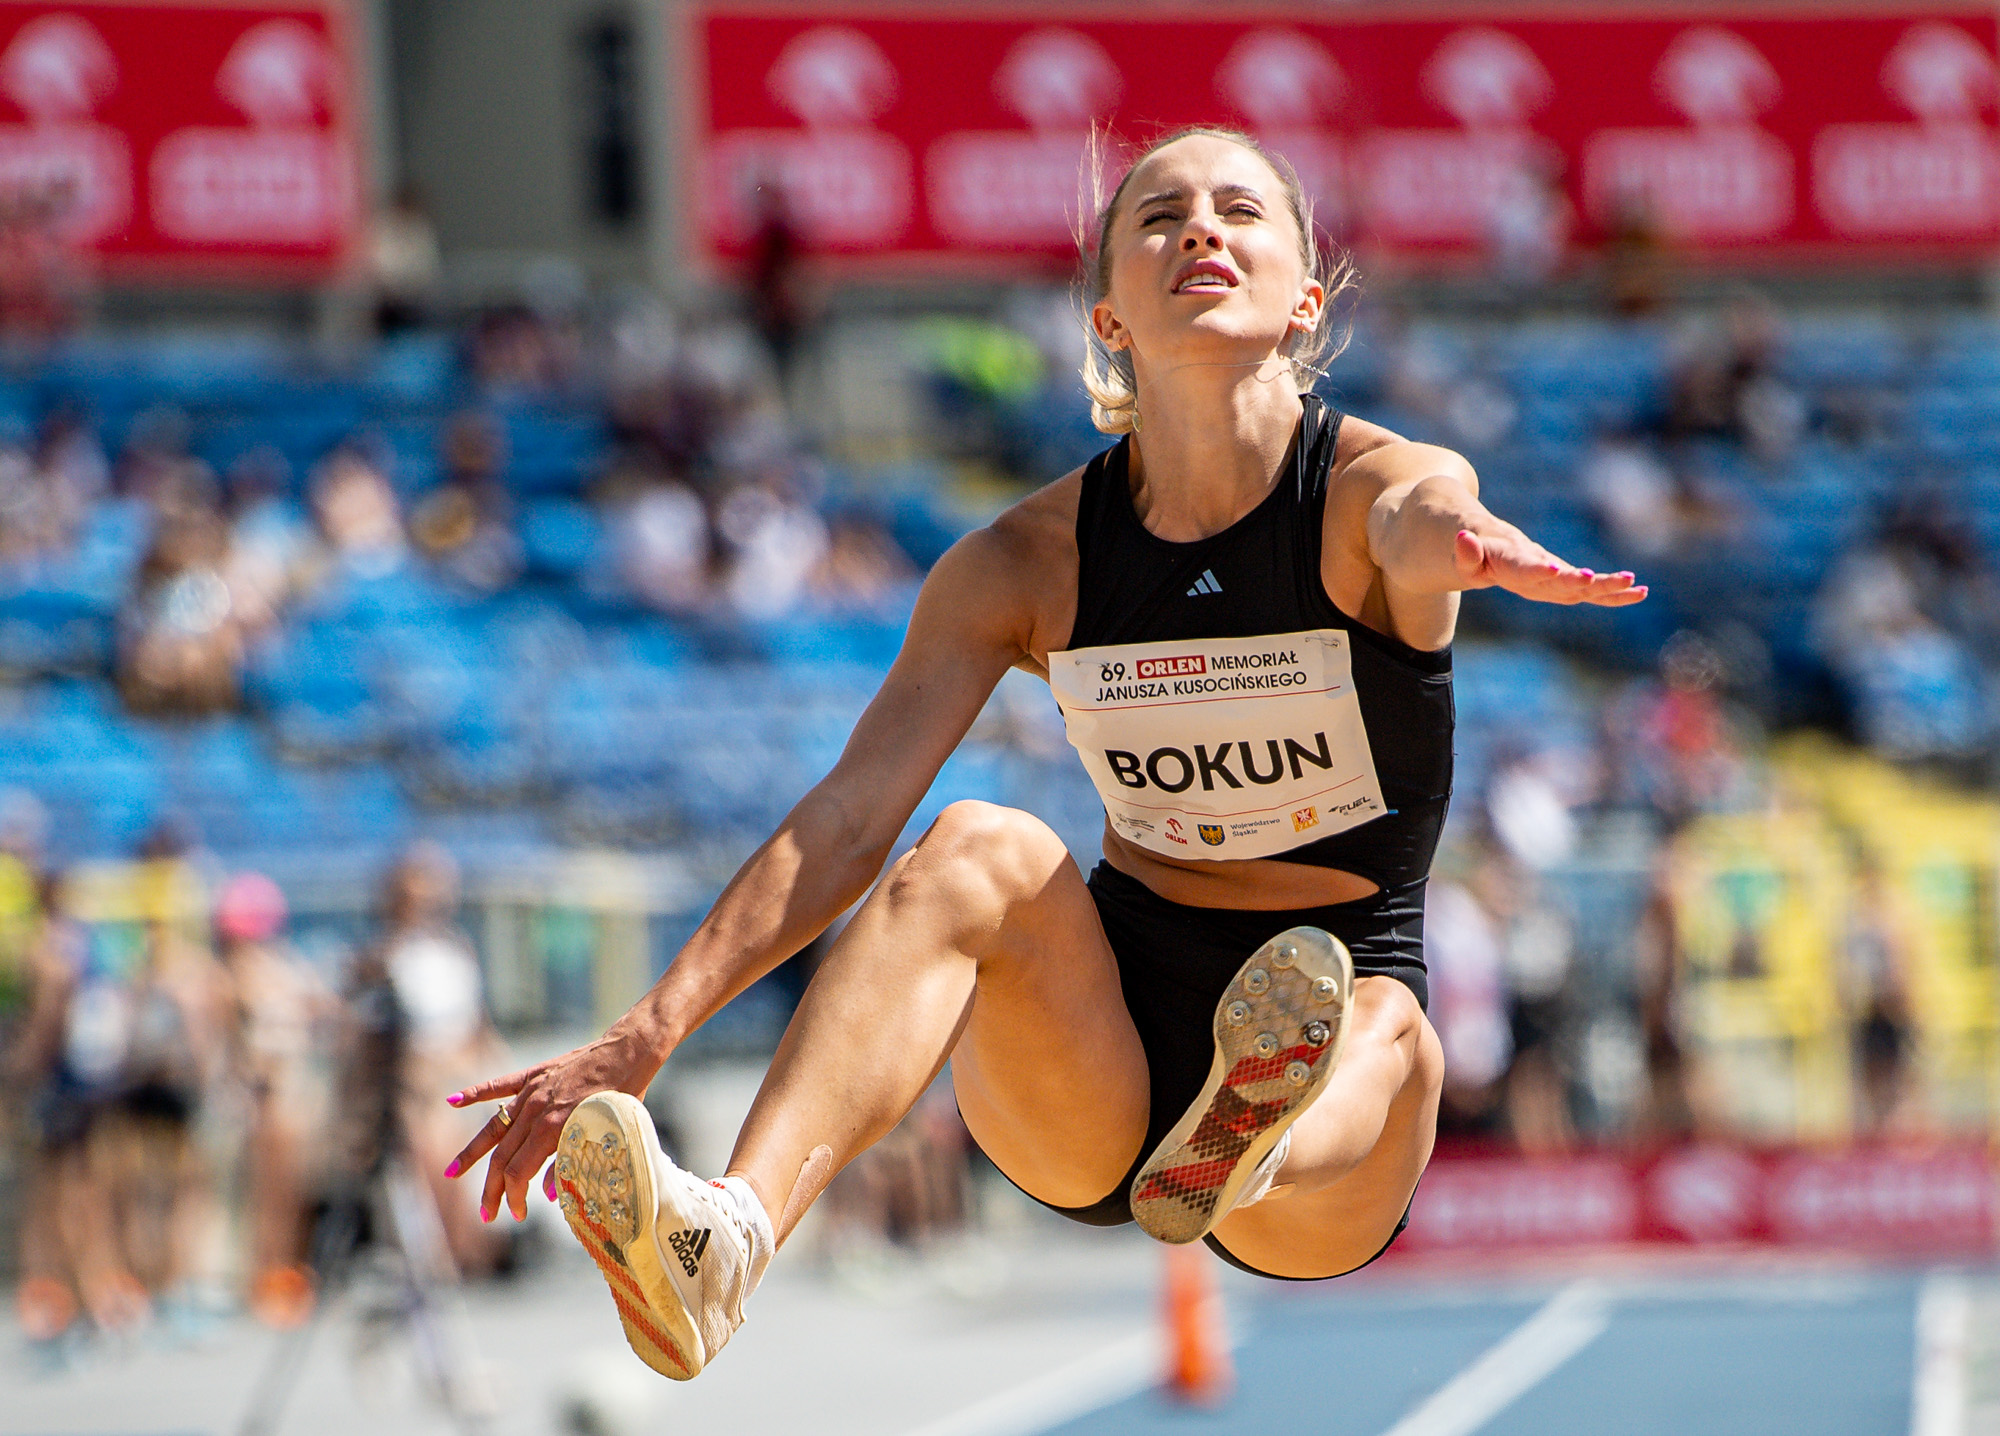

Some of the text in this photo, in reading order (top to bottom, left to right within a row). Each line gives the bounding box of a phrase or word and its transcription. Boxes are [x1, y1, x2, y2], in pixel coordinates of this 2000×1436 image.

[1101, 650, 1299, 682] 69. ORLEN MEMORIAŁ
[1096, 671, 1307, 702] JANUSZA KUSOCIŃSKIEGO
[1104, 731, 1334, 794] BOKUN
[1164, 832, 1188, 845] ORLEN
[1230, 818, 1281, 830] Województwo
[668, 1231, 699, 1278] adidas
